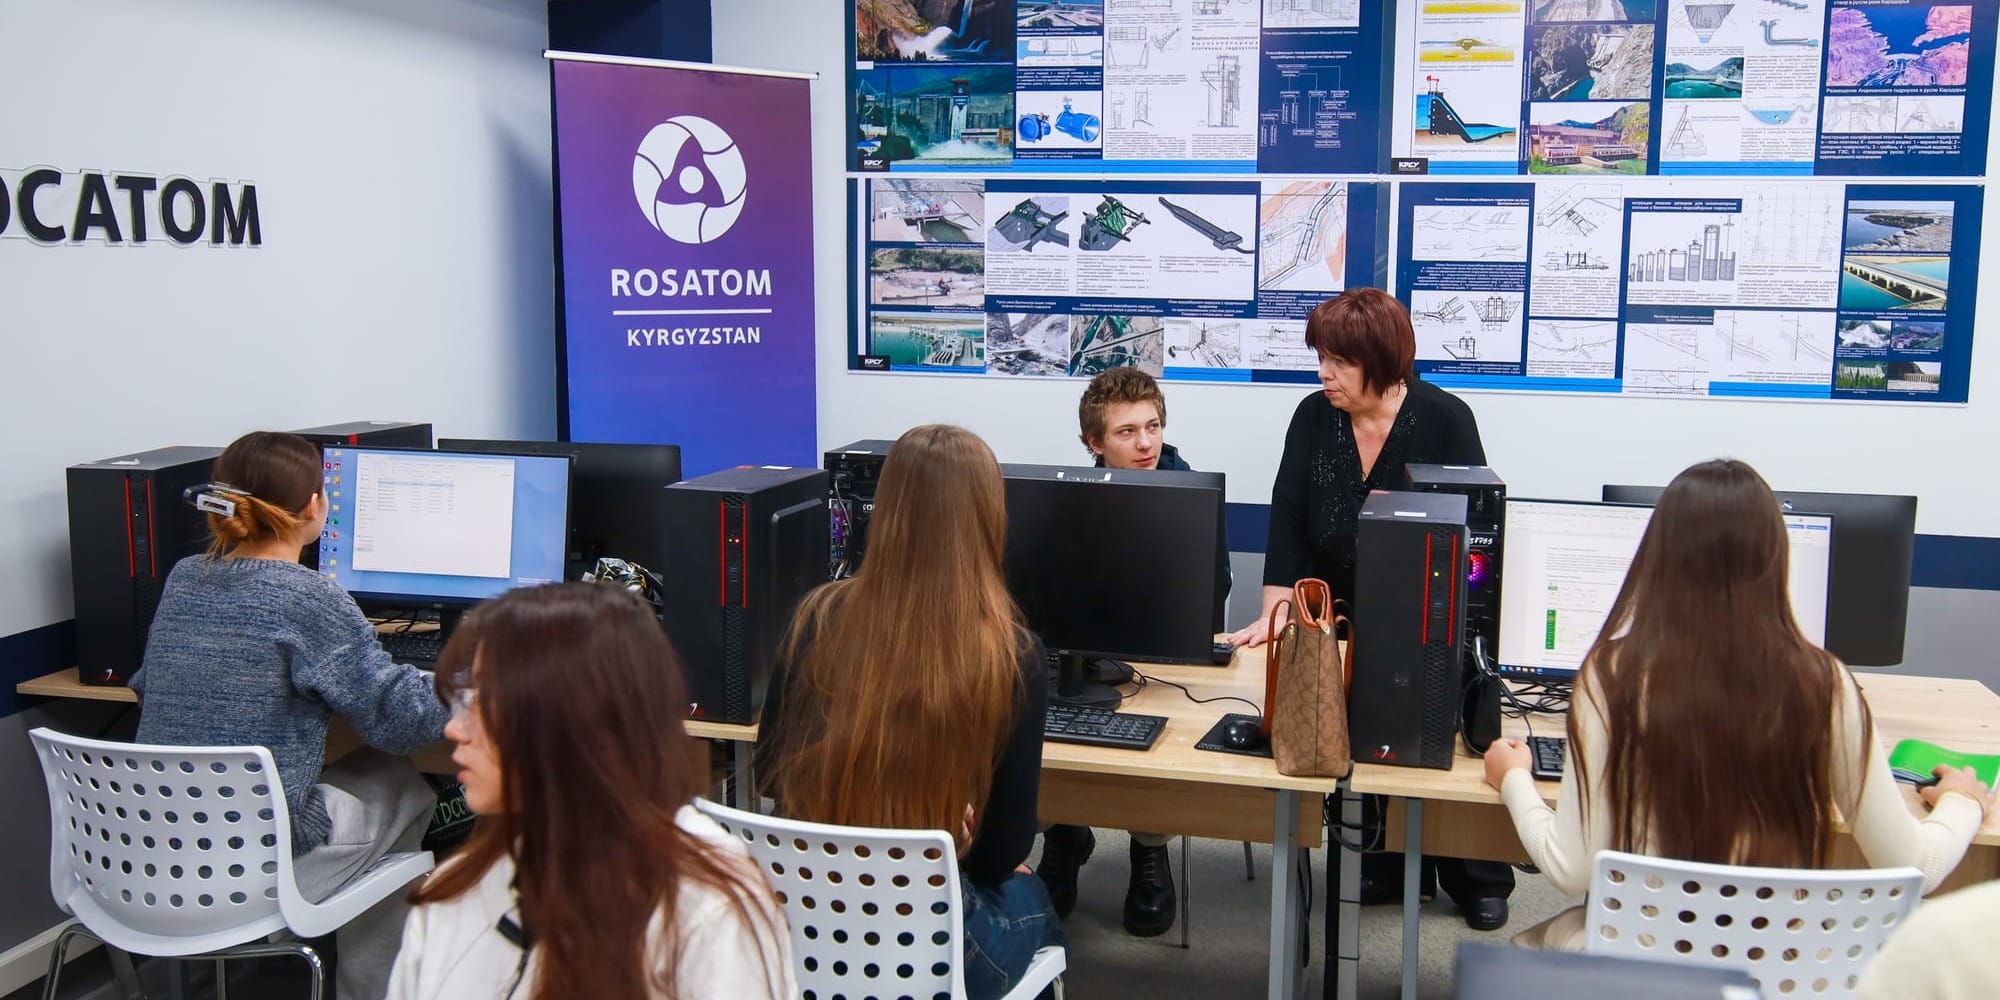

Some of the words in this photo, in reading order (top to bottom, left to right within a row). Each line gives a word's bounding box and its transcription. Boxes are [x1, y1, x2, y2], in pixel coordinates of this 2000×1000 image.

[0, 168, 262, 245] САТОМ
[611, 268, 772, 297] ROSATOM
[627, 327, 760, 346] KYRGYZSTAN
